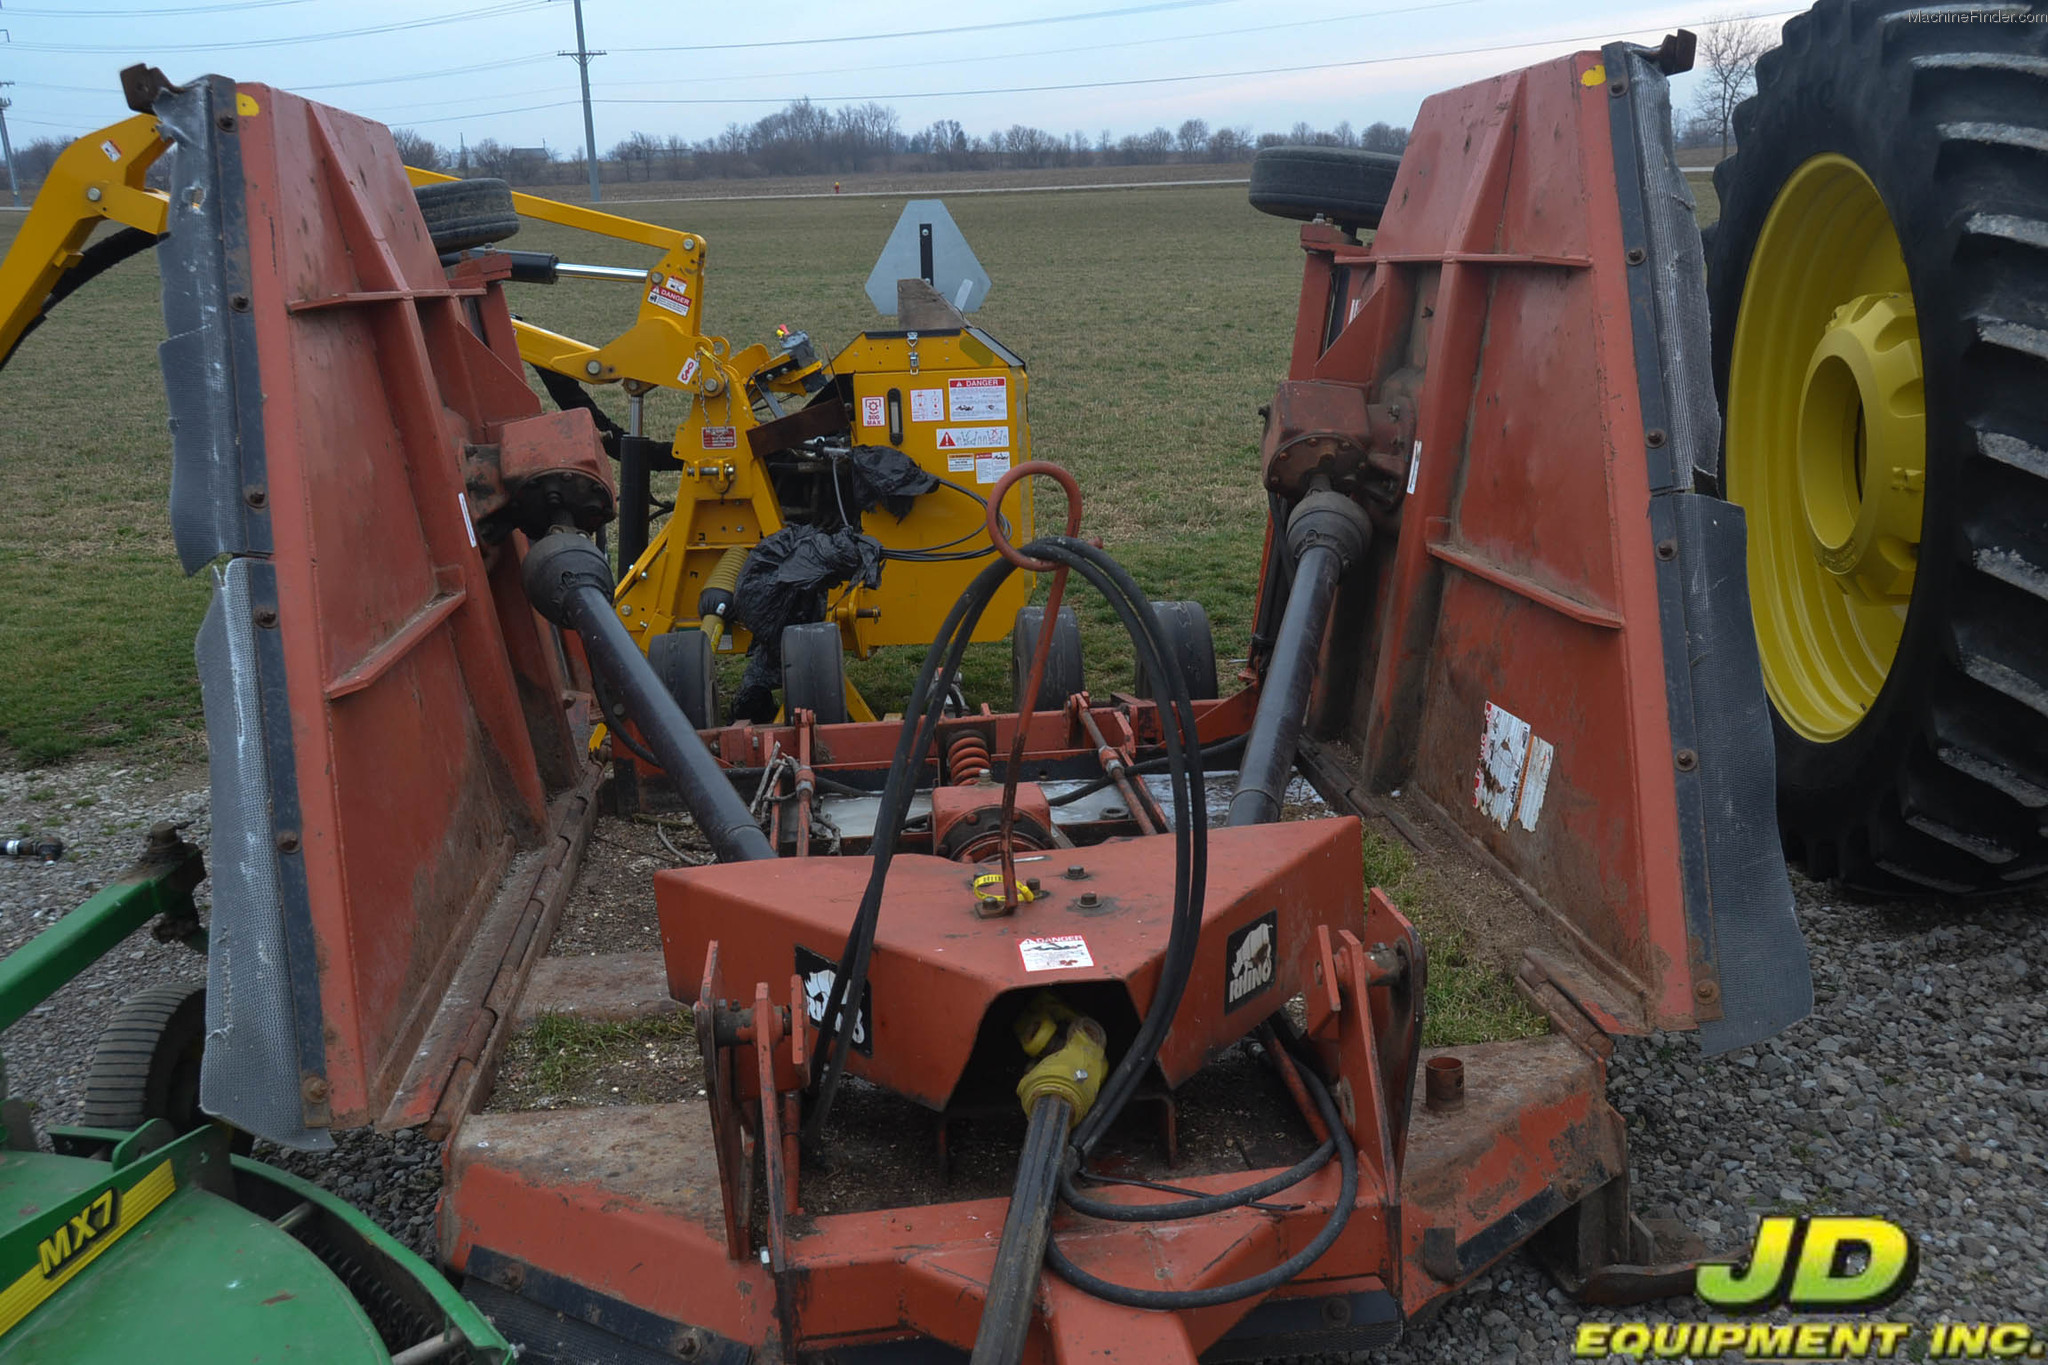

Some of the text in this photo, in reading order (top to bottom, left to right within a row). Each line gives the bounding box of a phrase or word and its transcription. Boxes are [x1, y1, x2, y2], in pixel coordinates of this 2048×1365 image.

[661, 289, 690, 305] DANGER
[966, 379, 999, 387] DANGER
[1035, 935, 1083, 944] DANGER
[1229, 958, 1272, 1003] RHINO
[38, 1188, 114, 1276] MX7
